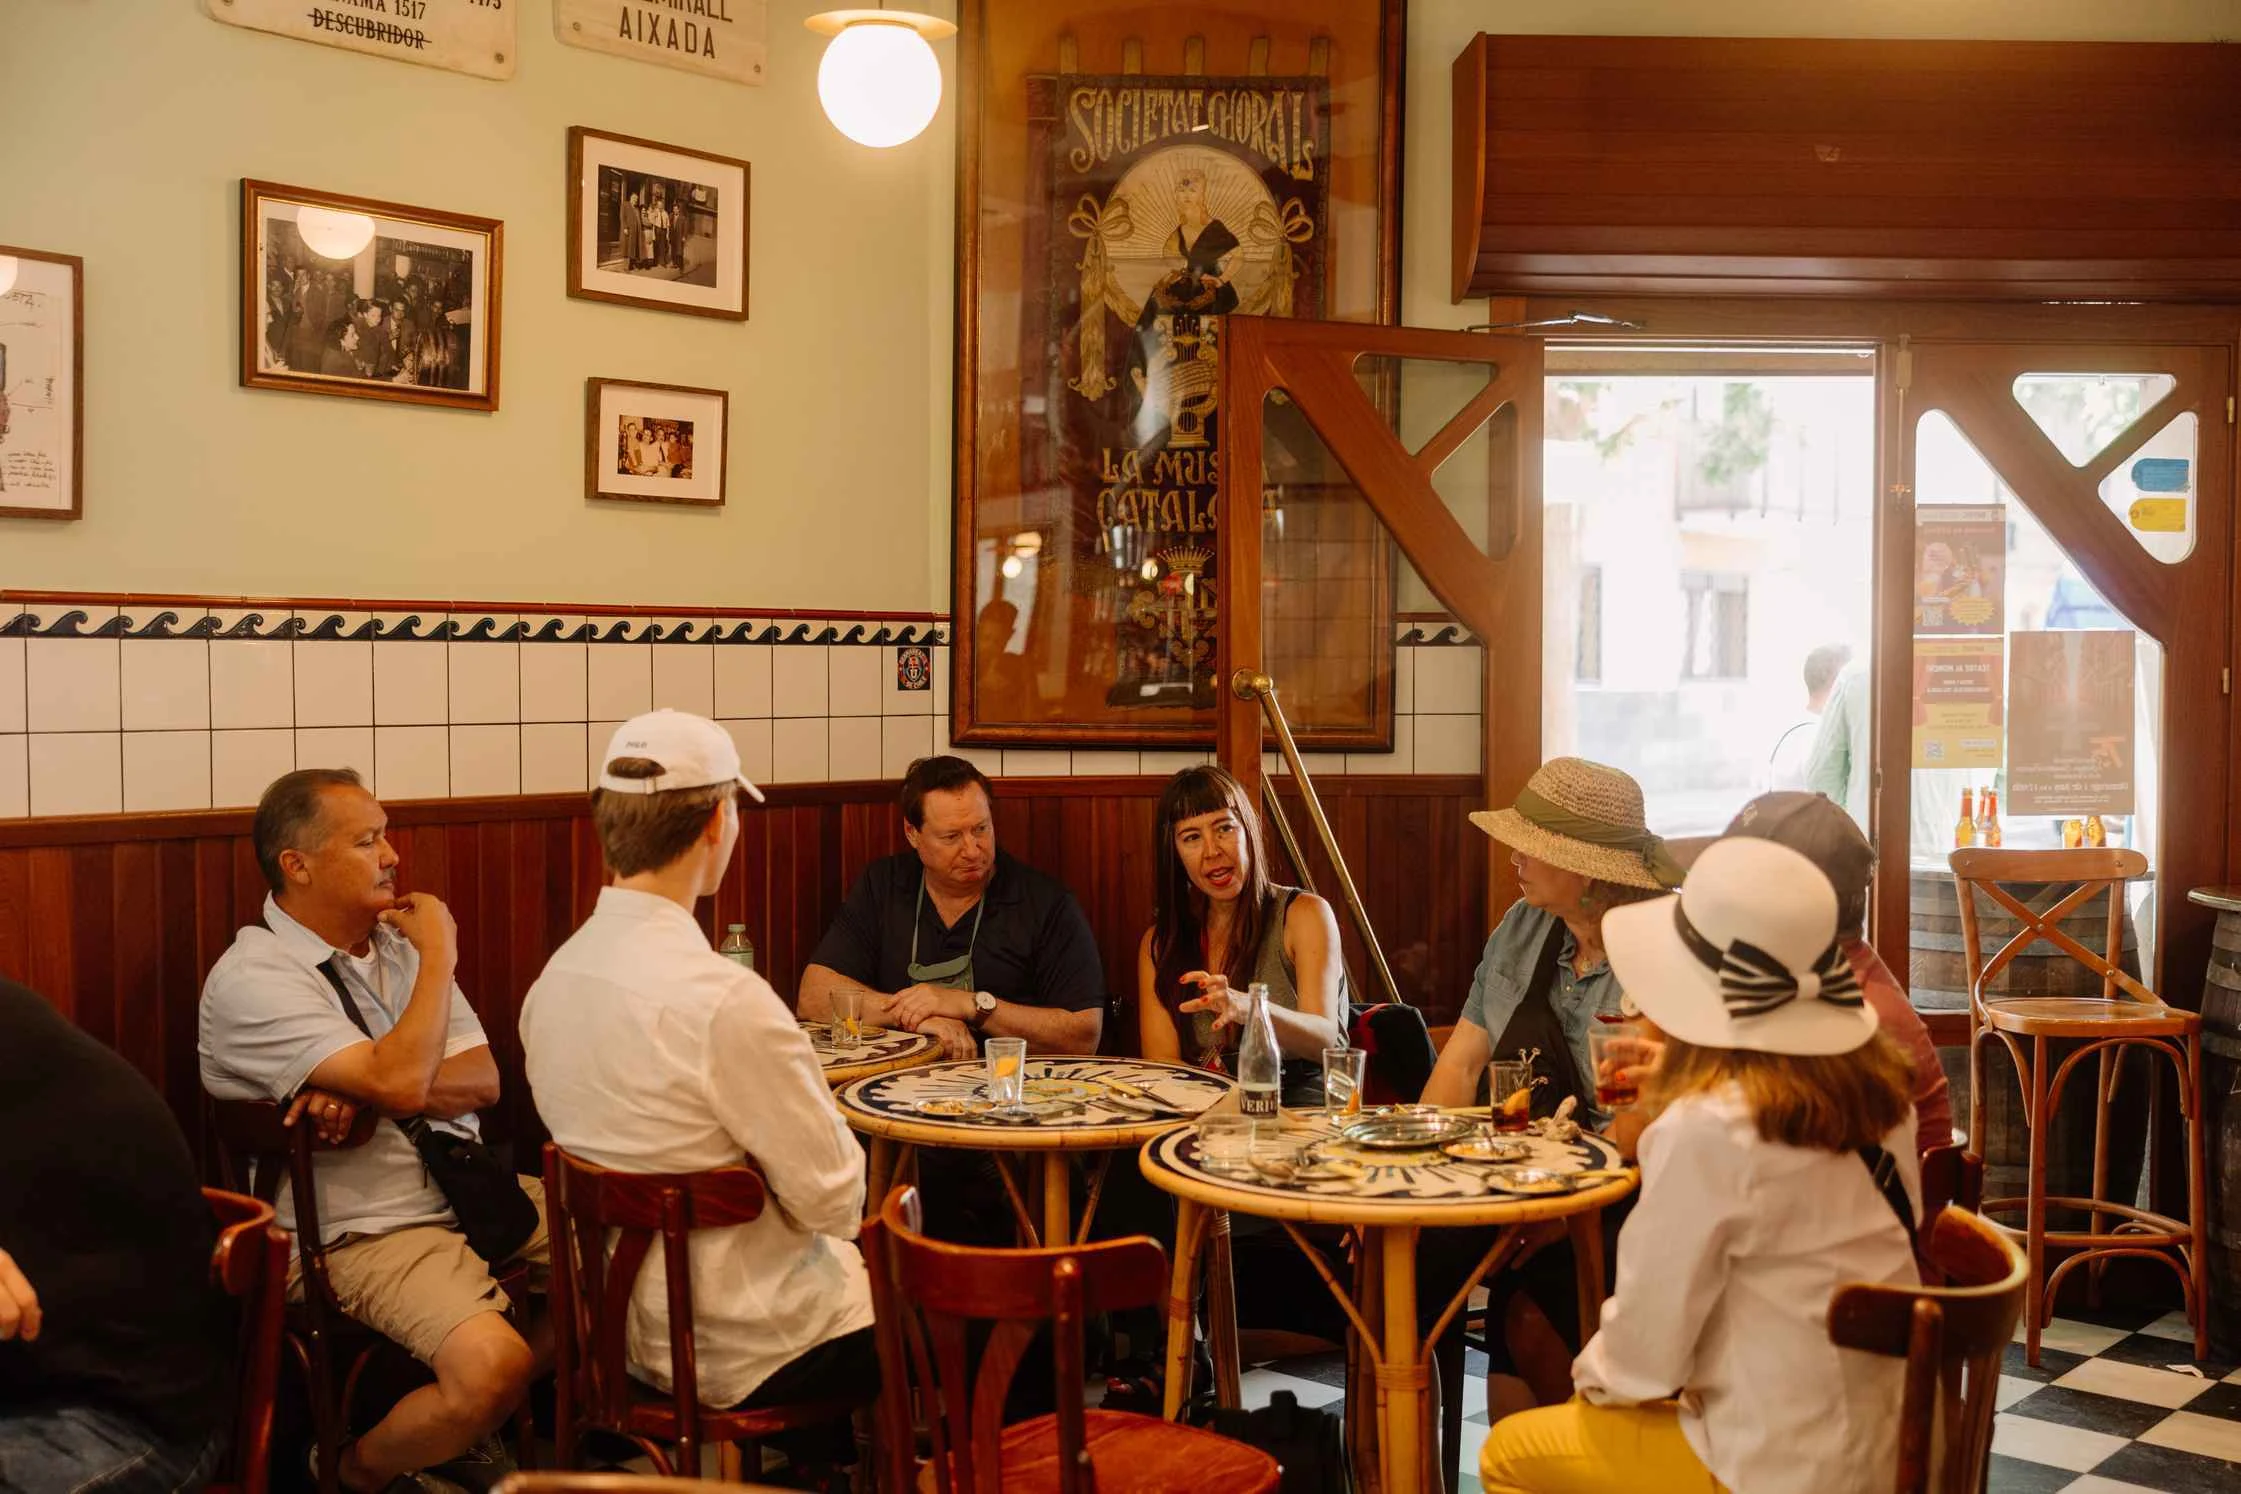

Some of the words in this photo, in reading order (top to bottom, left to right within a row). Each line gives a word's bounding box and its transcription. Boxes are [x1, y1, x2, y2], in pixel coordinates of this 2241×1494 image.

[312, 7, 425, 50] DESCUBRIDOR
[394, 0, 426, 20] 1517
[619, 6, 716, 59] AIXADA
[1069, 87, 1204, 173] SOCIETAT
[1207, 86, 1315, 182] CHORAL
[1102, 447, 1143, 484] LA
